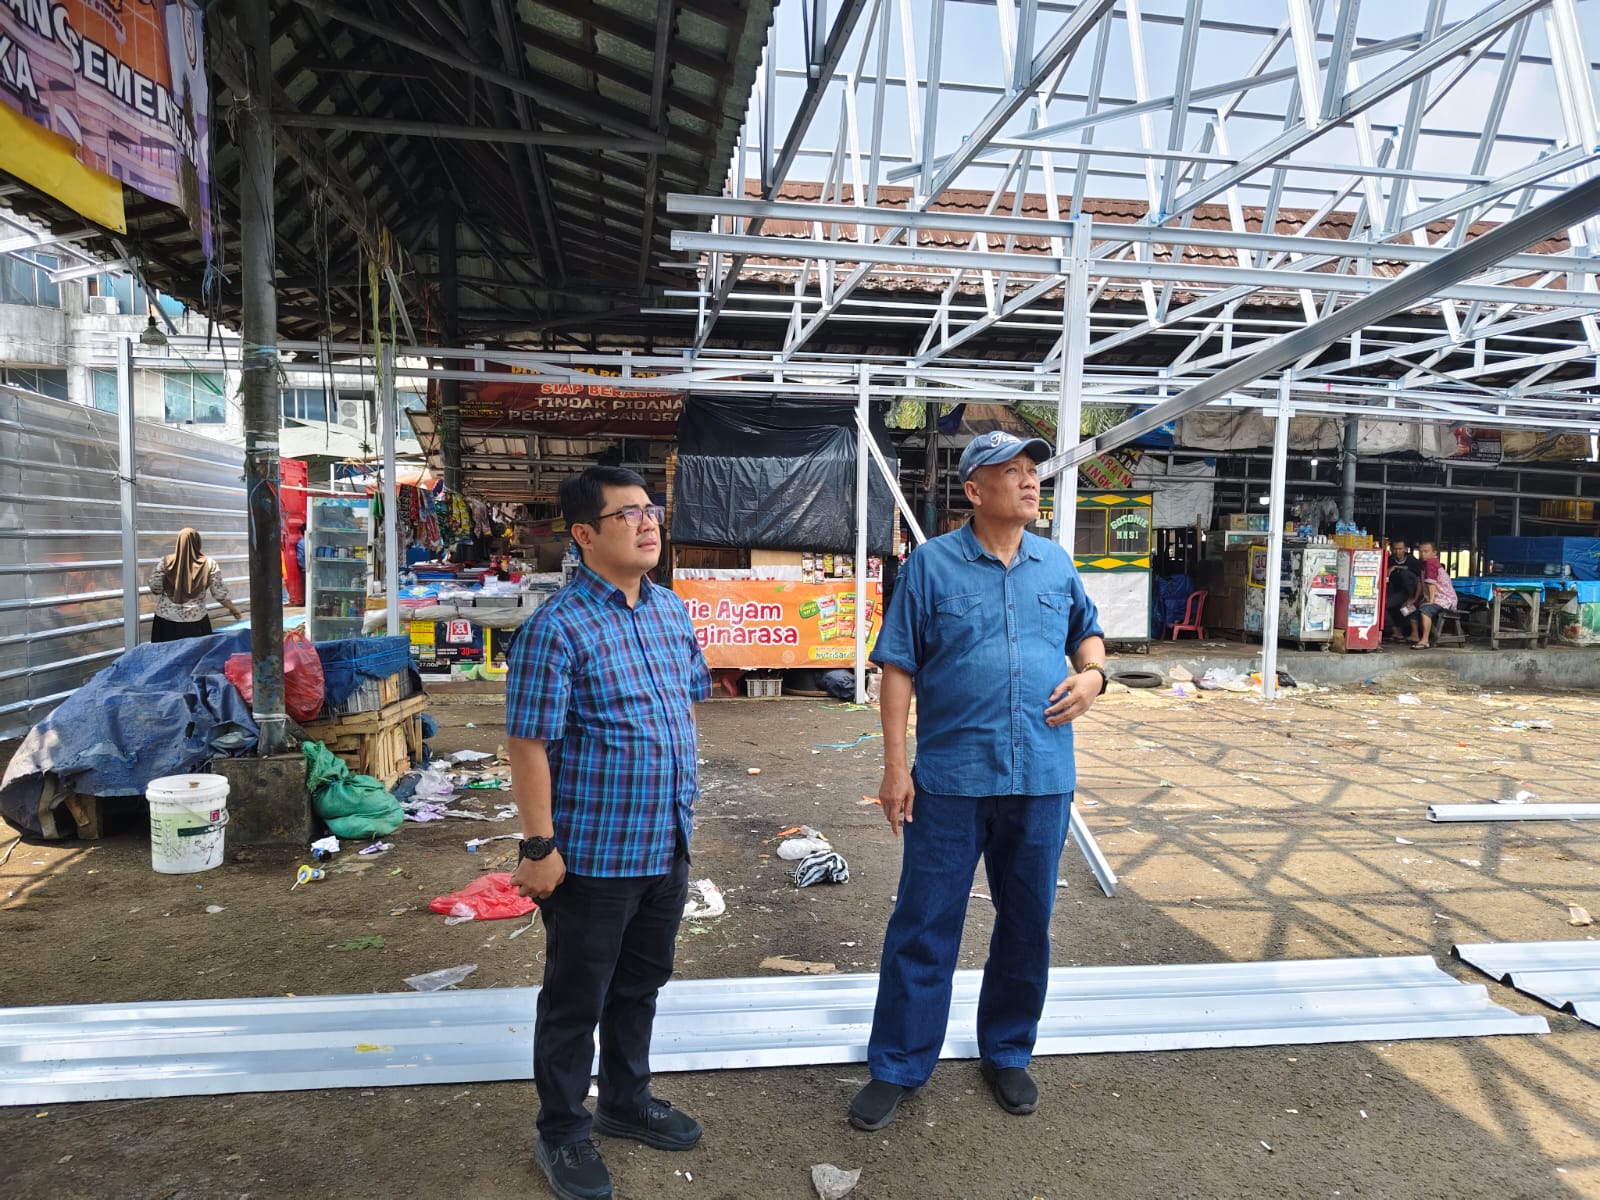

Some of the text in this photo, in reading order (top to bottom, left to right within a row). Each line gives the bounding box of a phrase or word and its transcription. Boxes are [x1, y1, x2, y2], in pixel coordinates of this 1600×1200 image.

[541, 383, 584, 395] SIAP
[534, 397, 684, 411] TINDAK PIDANA
[717, 600, 781, 625] Ayam
[694, 625, 798, 648] ginarasa
